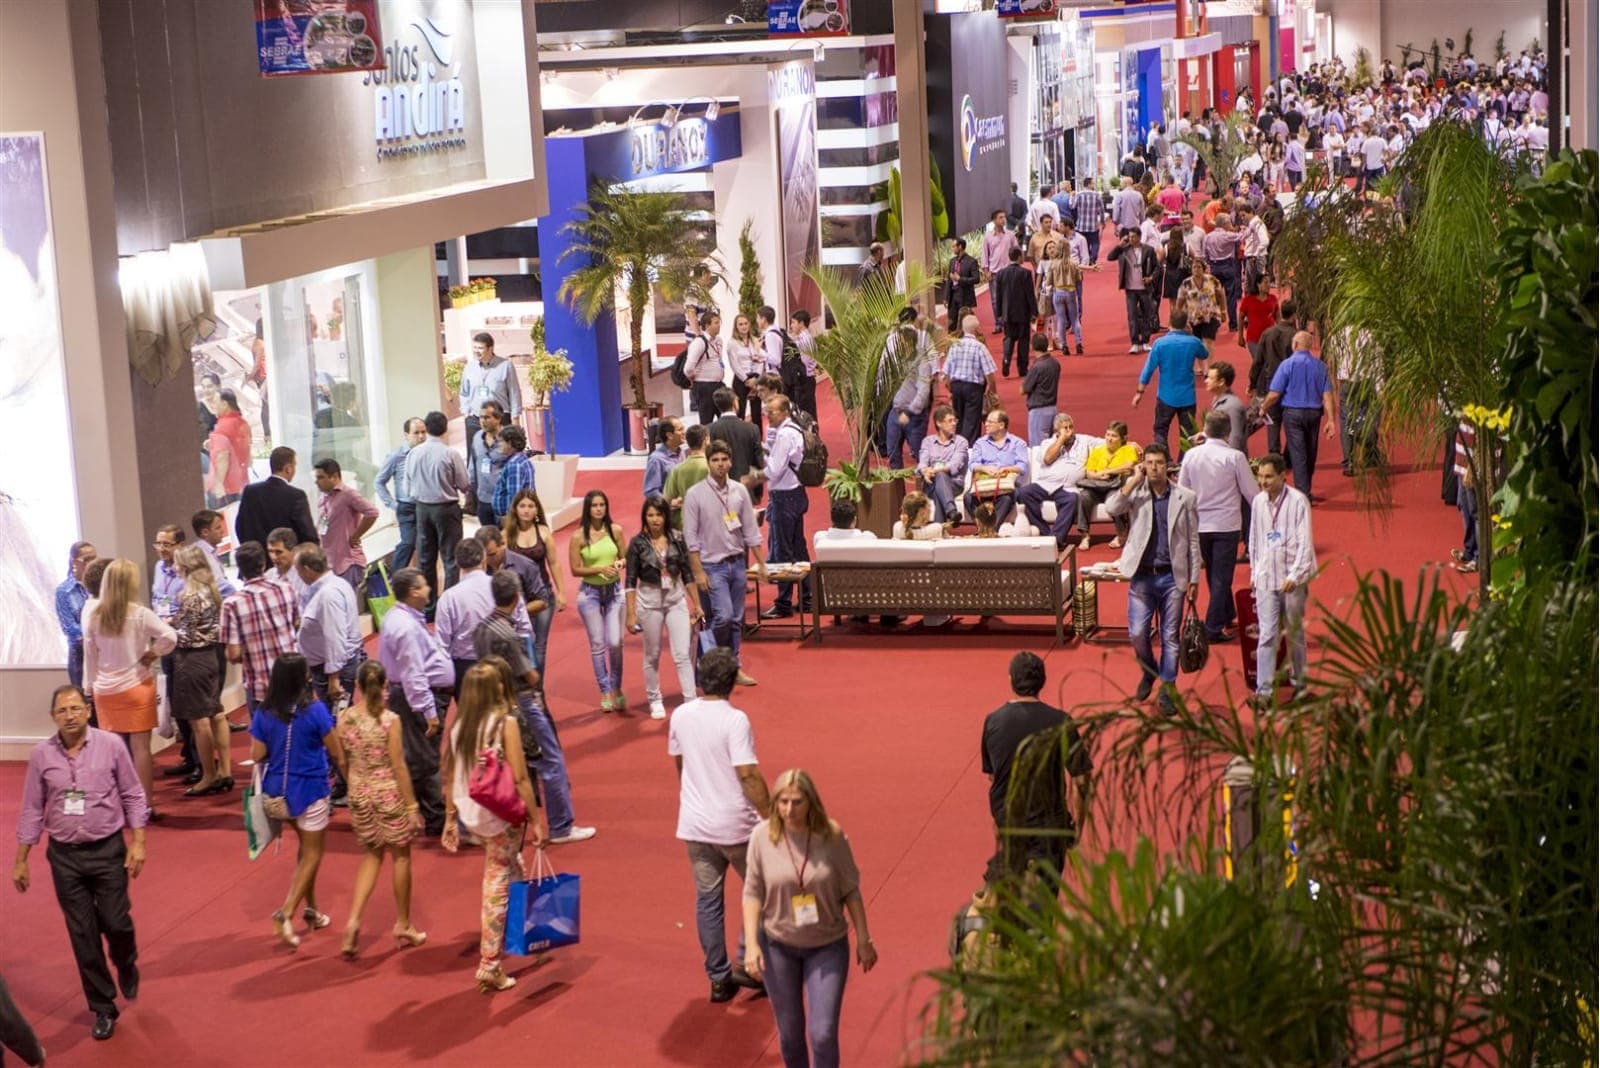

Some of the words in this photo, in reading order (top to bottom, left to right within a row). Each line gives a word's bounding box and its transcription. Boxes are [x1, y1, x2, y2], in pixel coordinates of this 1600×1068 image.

[260, 44, 302, 58] SEBRAE
[768, 64, 816, 101] DURANOX
[631, 121, 709, 175] DURANOX
